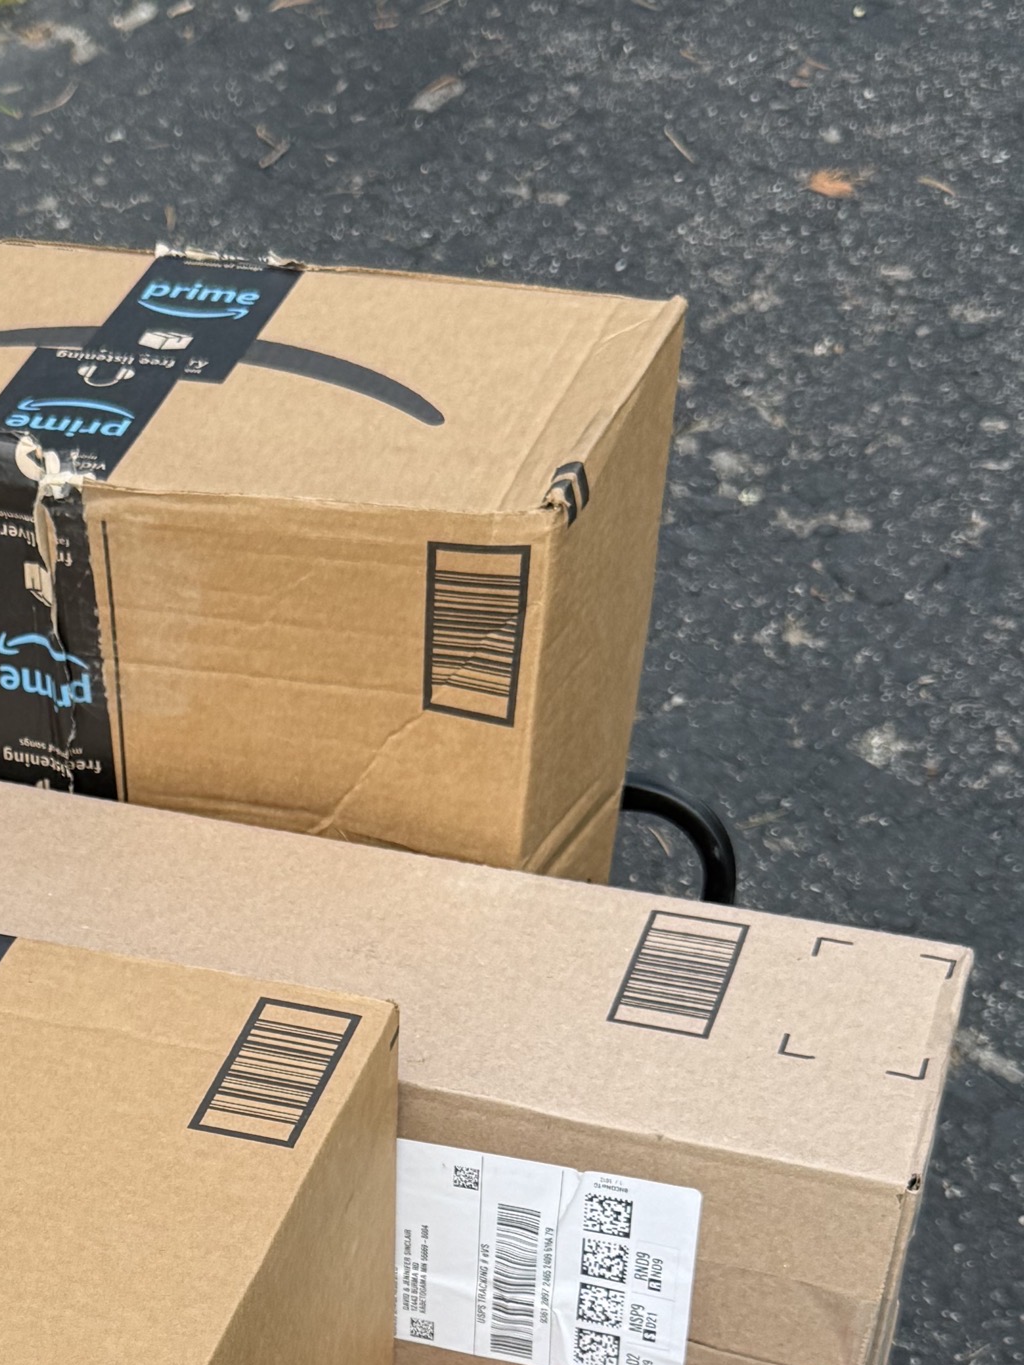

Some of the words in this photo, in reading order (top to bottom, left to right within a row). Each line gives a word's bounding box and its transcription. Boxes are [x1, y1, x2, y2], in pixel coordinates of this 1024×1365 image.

[141, 281, 260, 305] prime
[56, 349, 135, 365] listening
[139, 353, 176, 369] free
[5, 411, 133, 438] prime
[0, 664, 91, 712] prime
[403, 1228, 411, 1255] SINCLAIR
[634, 1251, 650, 1281] RND9
[477, 1265, 488, 1303] TRACKING
[477, 1304, 486, 1323] USPS
[539, 1307, 548, 1323] 9361
[629, 1302, 644, 1333] MSP9
